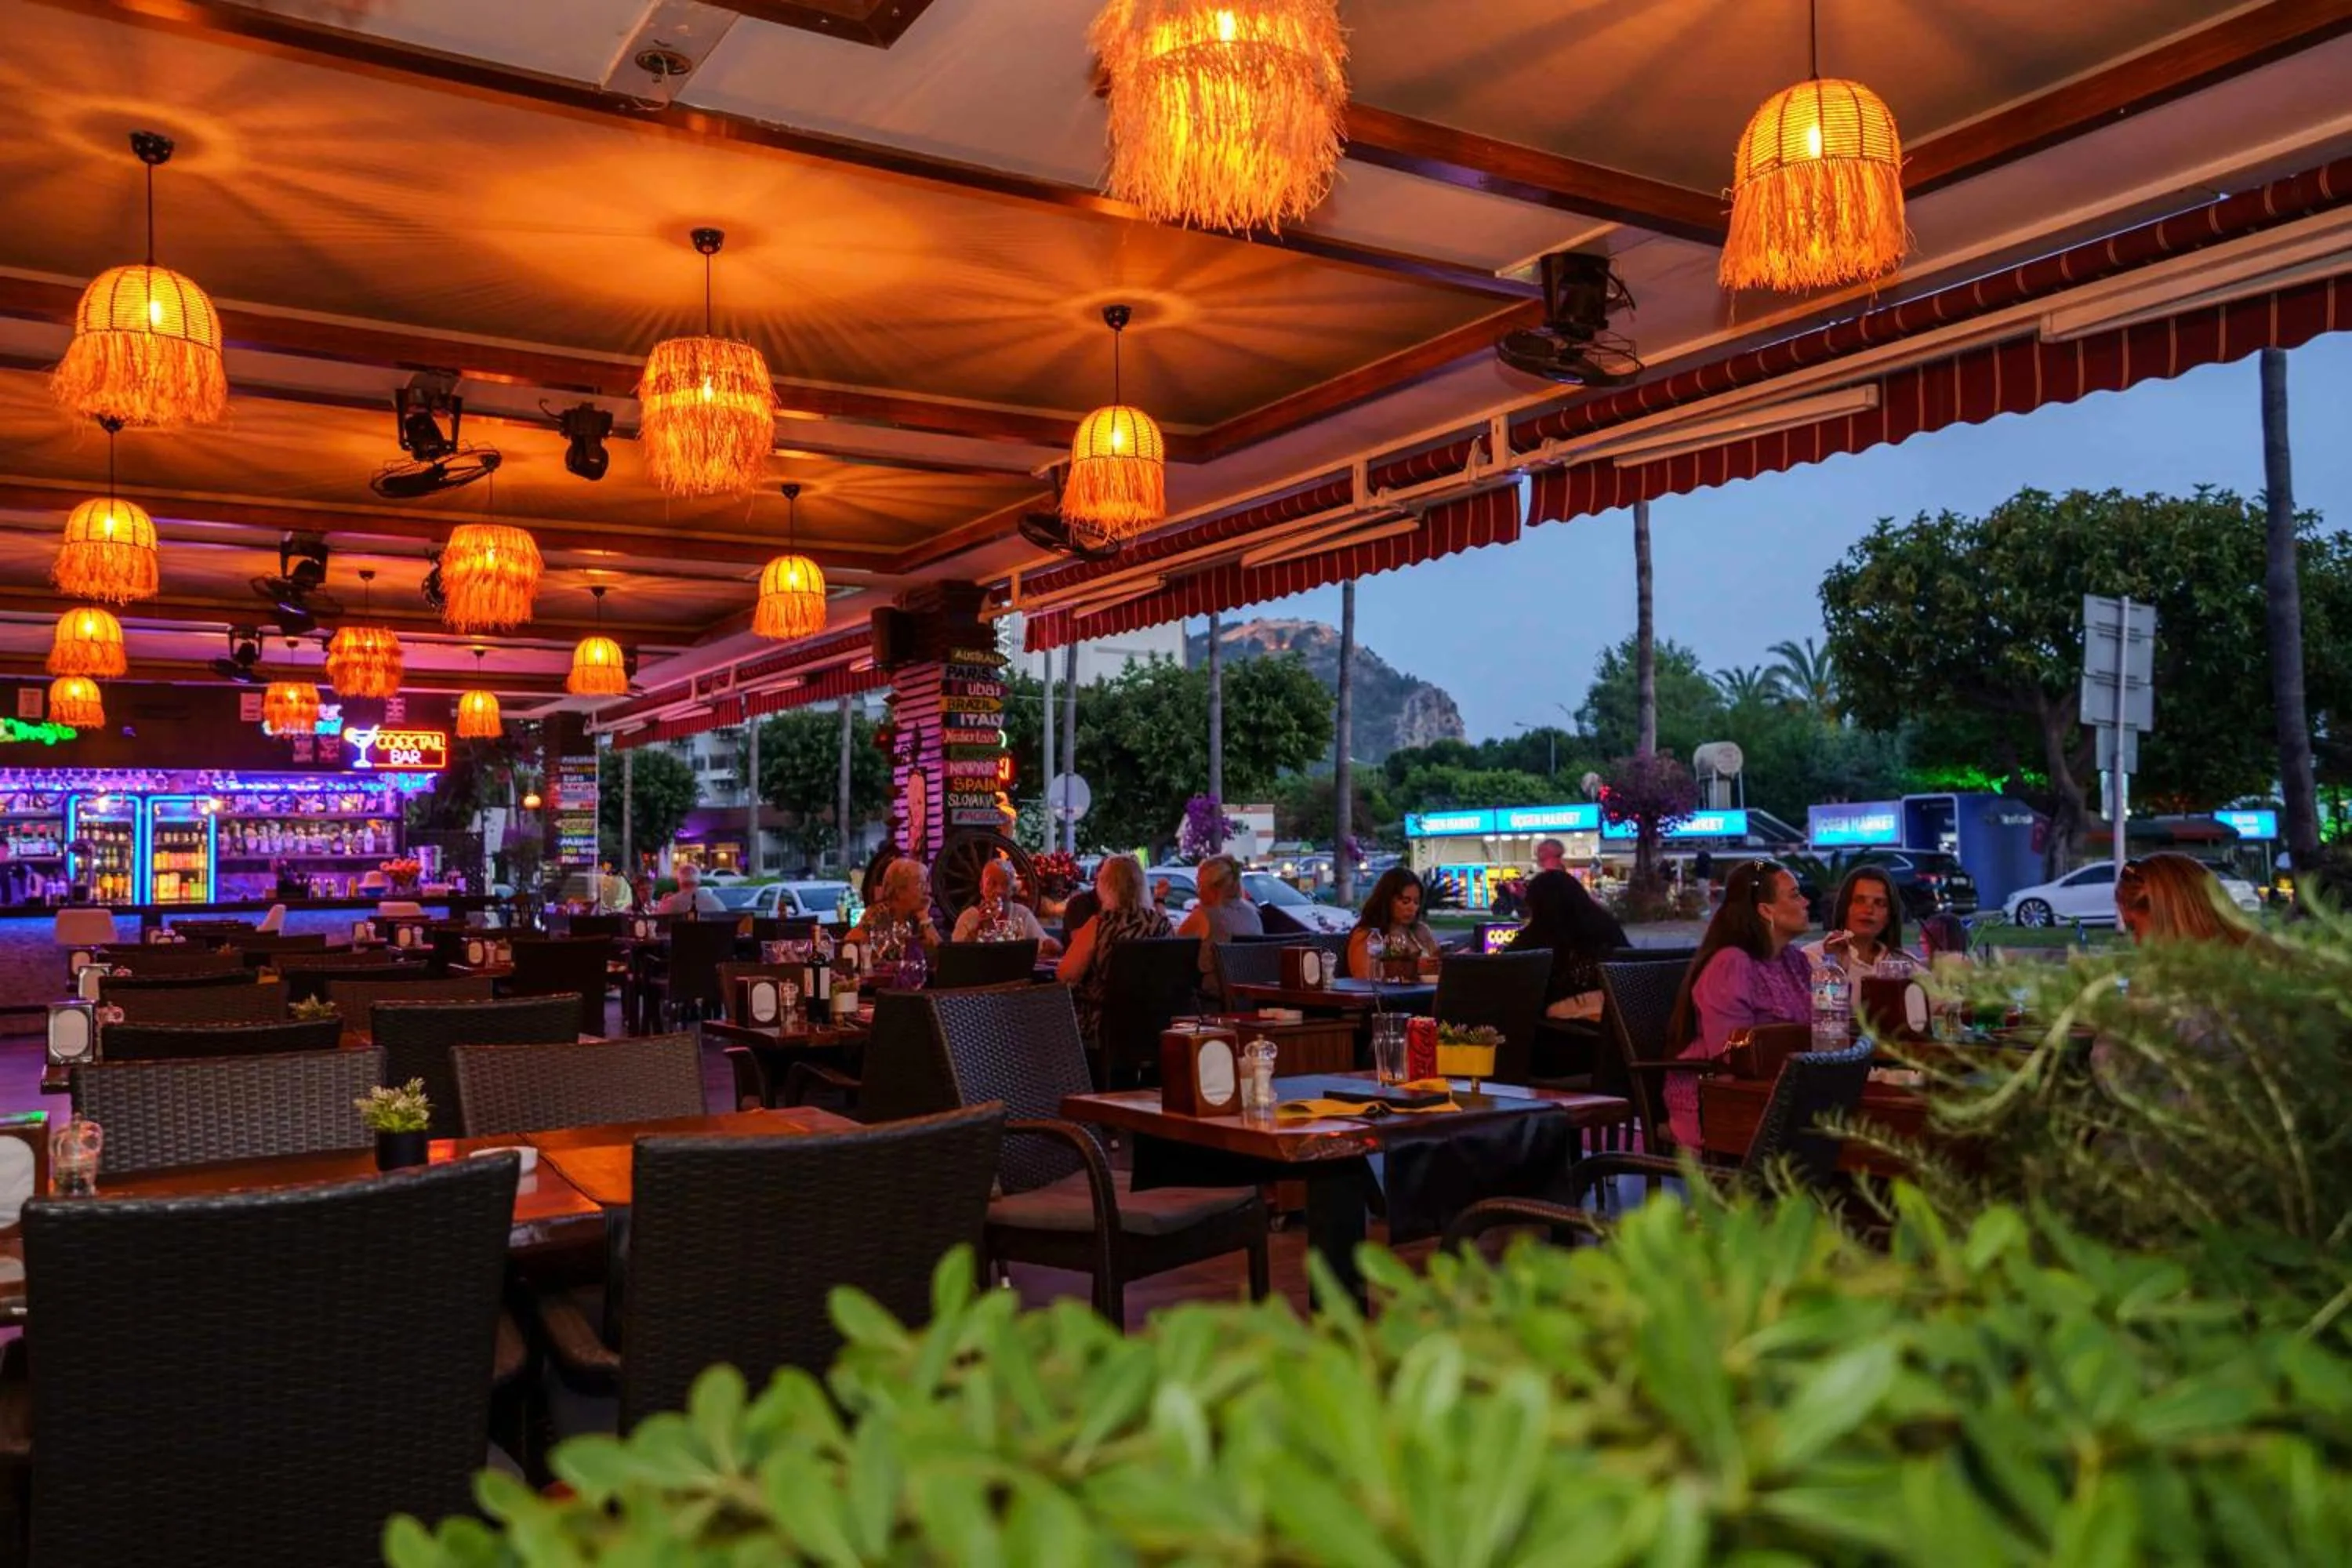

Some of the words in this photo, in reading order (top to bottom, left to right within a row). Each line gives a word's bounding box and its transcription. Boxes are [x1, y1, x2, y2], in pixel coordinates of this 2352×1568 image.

[960, 713, 1004, 728] ITALY
[376, 732, 446, 751] COCKTAIL
[390, 749, 422, 765] BAR
[953, 777, 1001, 792] SPAIN
[1850, 814, 1894, 831] MARKET
